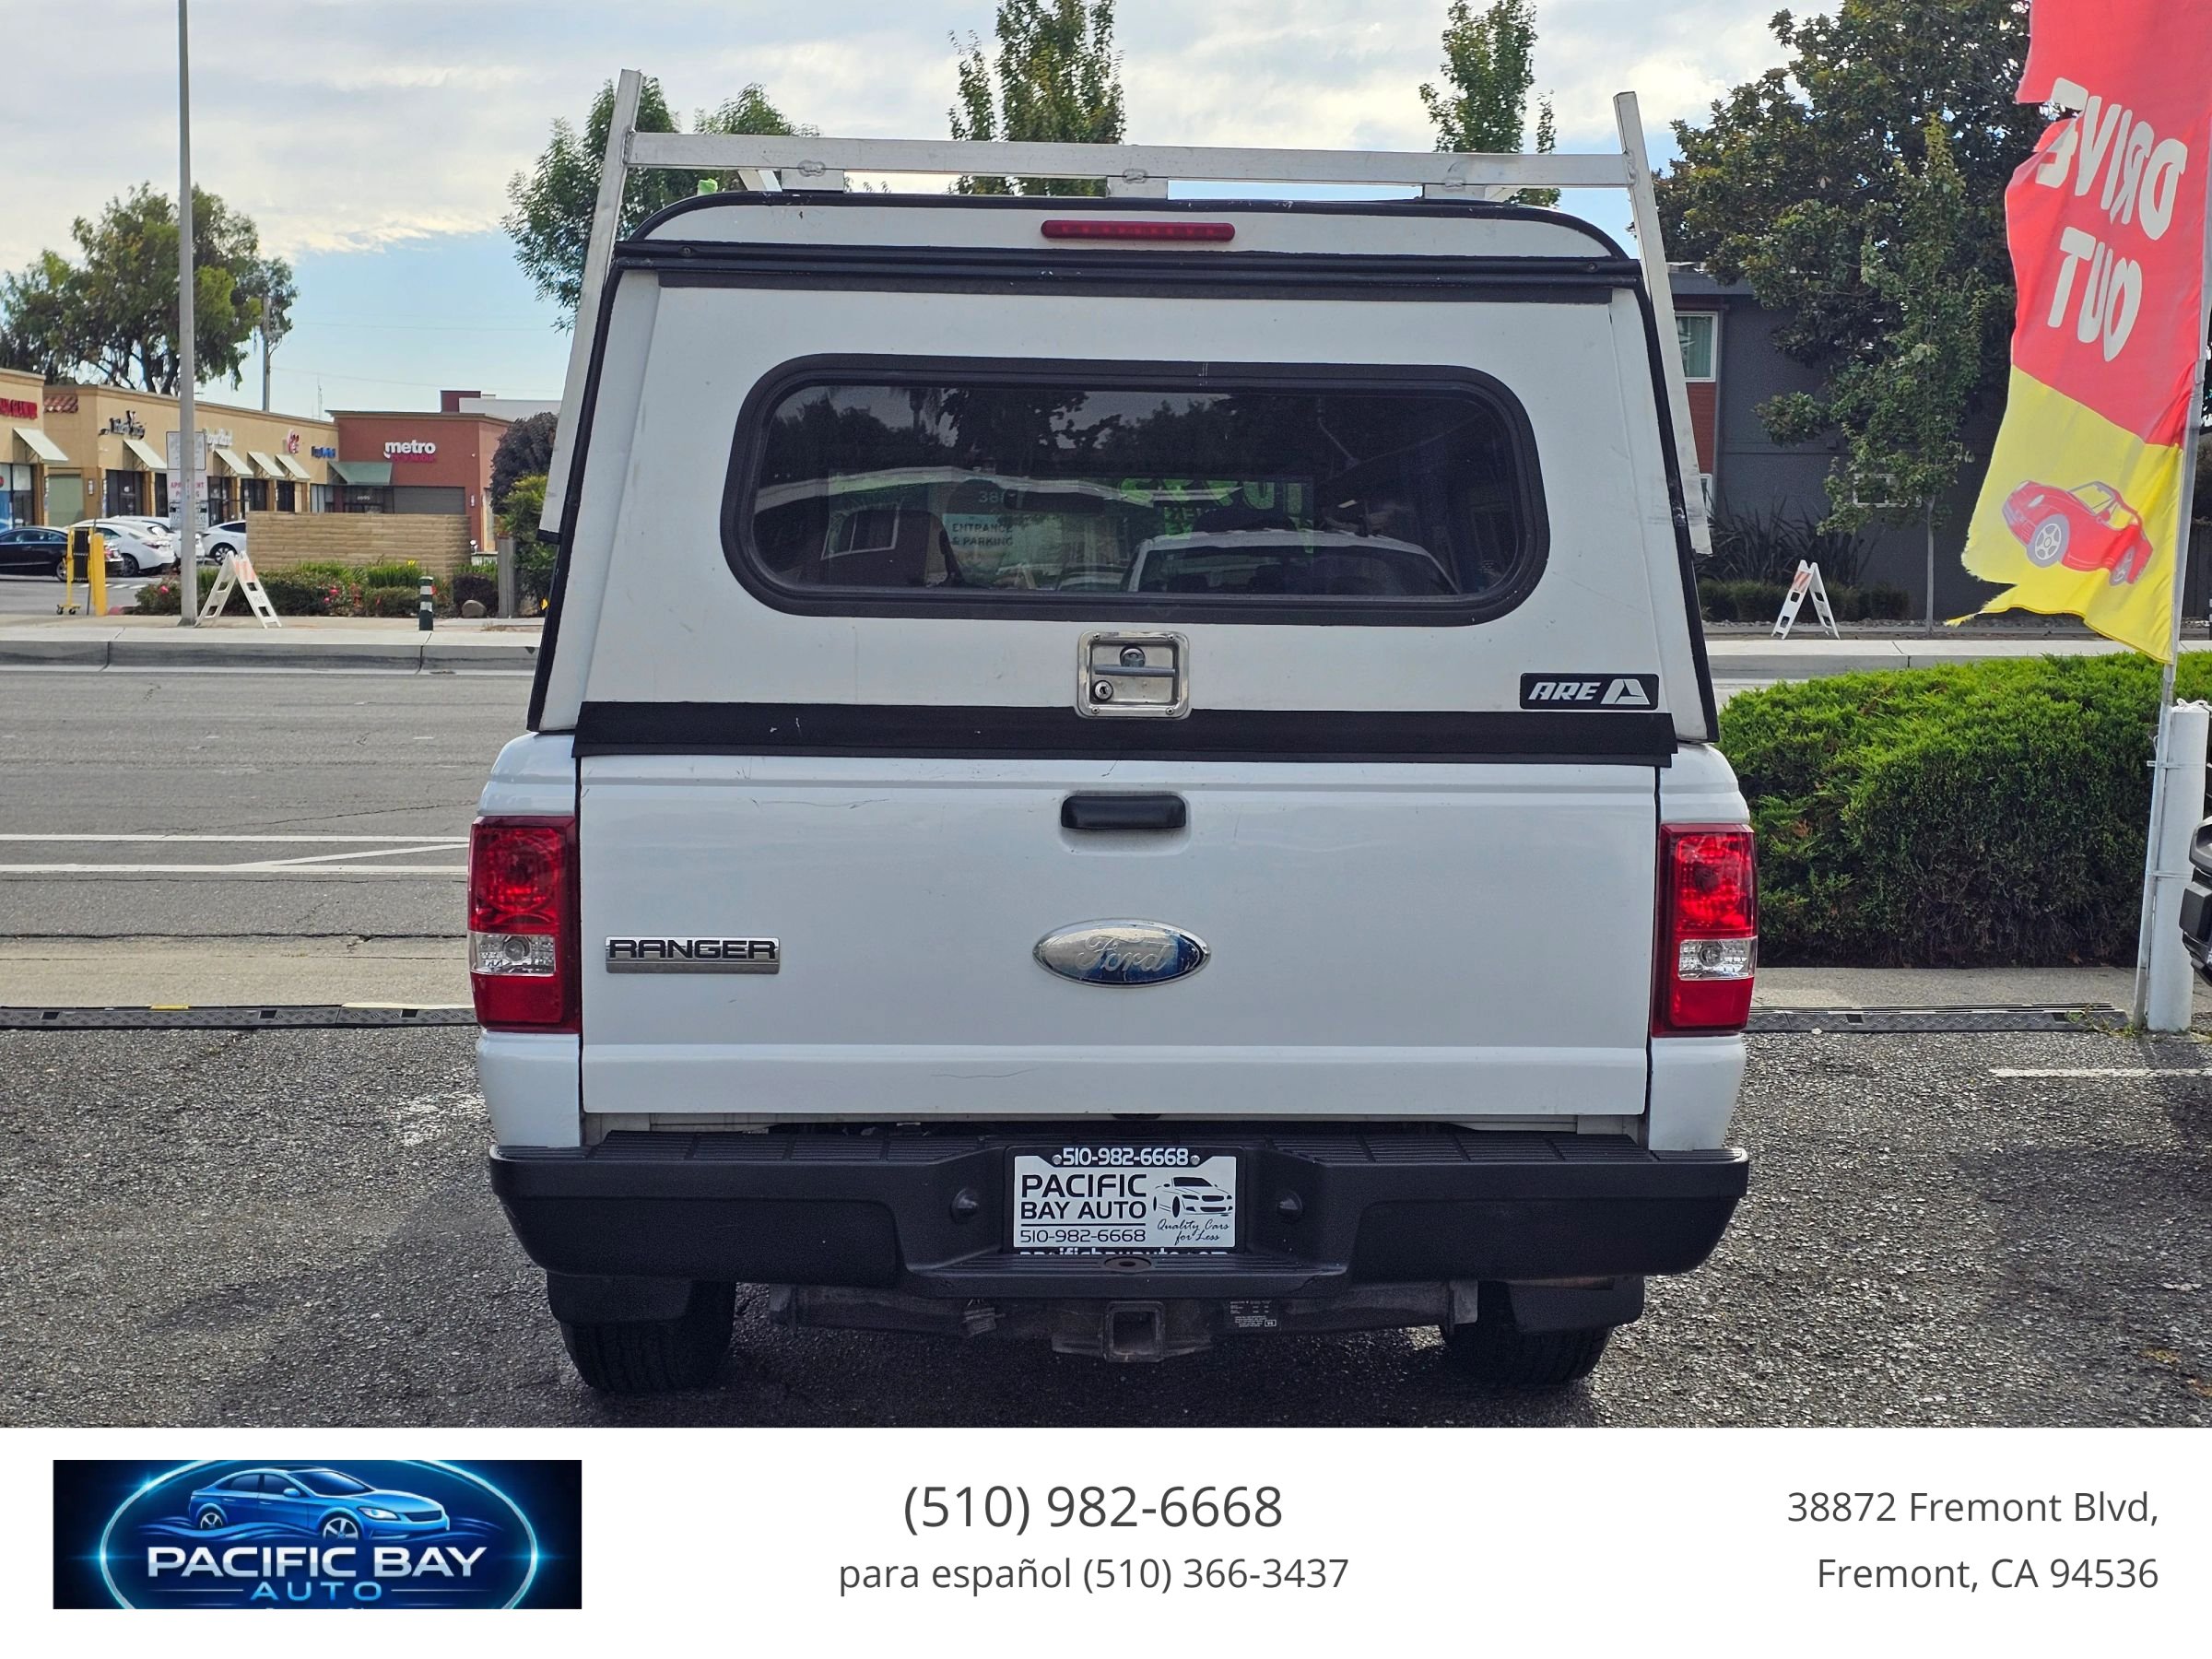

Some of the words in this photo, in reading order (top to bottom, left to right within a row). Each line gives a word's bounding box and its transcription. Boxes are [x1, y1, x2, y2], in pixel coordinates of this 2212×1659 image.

[384, 439, 436, 454] metro
[952, 523, 1013, 534] ENTRANCE
[963, 536, 1014, 547] PARKING
[1528, 682, 1602, 700] ARE
[608, 939, 776, 959] RANGER
[1076, 934, 1173, 972] Ford
[1062, 1147, 1189, 1166] 510-982-6668
[1021, 1173, 1147, 1198] PACIFIC
[1020, 1201, 1071, 1219] BAY
[1077, 1201, 1147, 1219] AUTO
[1157, 1218, 1200, 1232] Quality
[1204, 1218, 1230, 1231] Cars
[1019, 1229, 1147, 1243] 510-982-6668
[1174, 1231, 1194, 1246] for
[1194, 1230, 1220, 1241] Less
